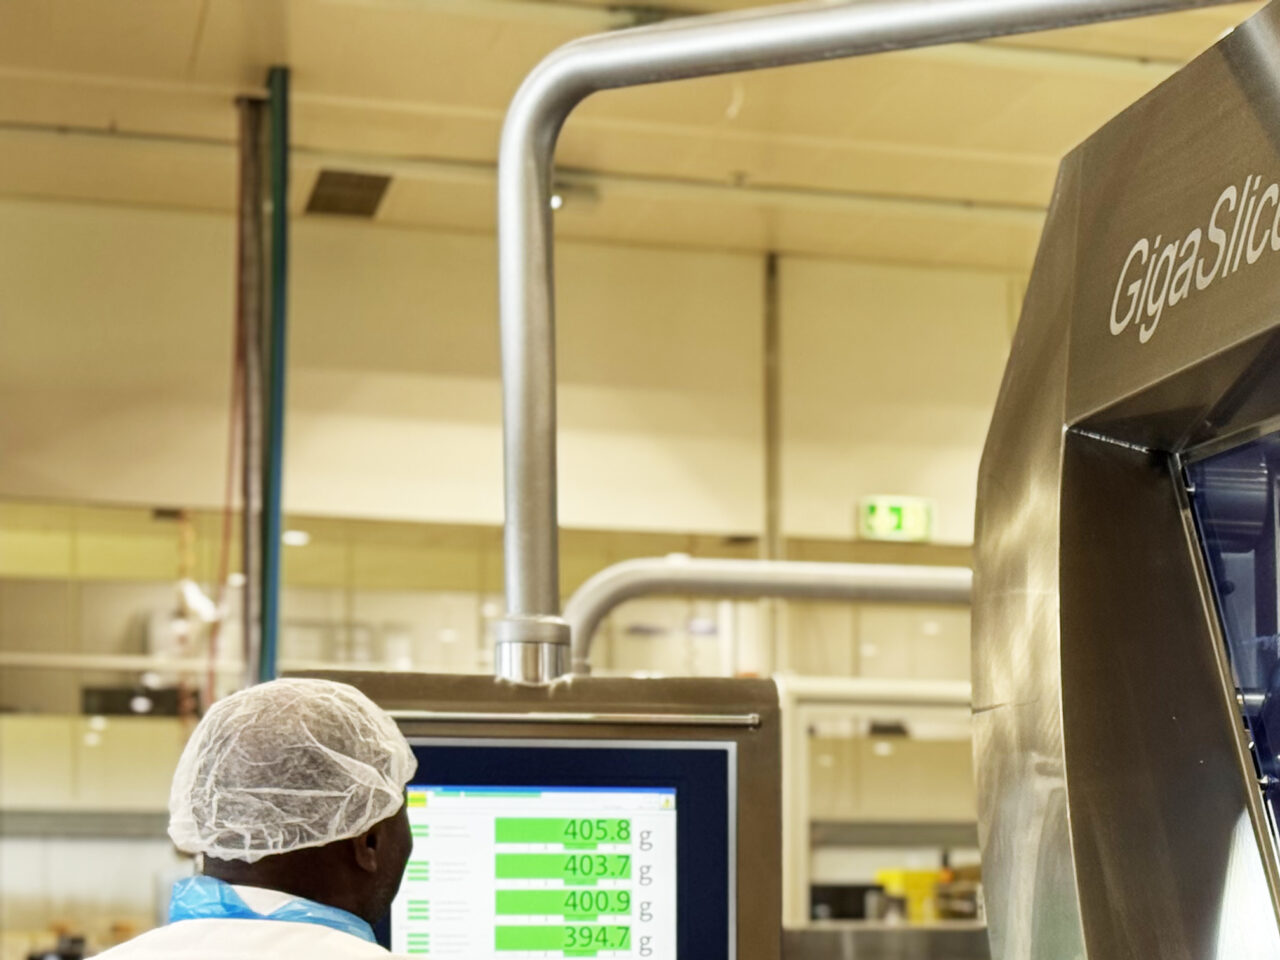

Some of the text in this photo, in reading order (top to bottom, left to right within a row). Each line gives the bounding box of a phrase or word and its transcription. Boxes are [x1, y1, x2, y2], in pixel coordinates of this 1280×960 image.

[564, 819, 653, 851] 405.8 g
[564, 855, 653, 886] 403.7 g
[564, 891, 653, 922] 400.9 g
[564, 927, 653, 957] 394.7 g
